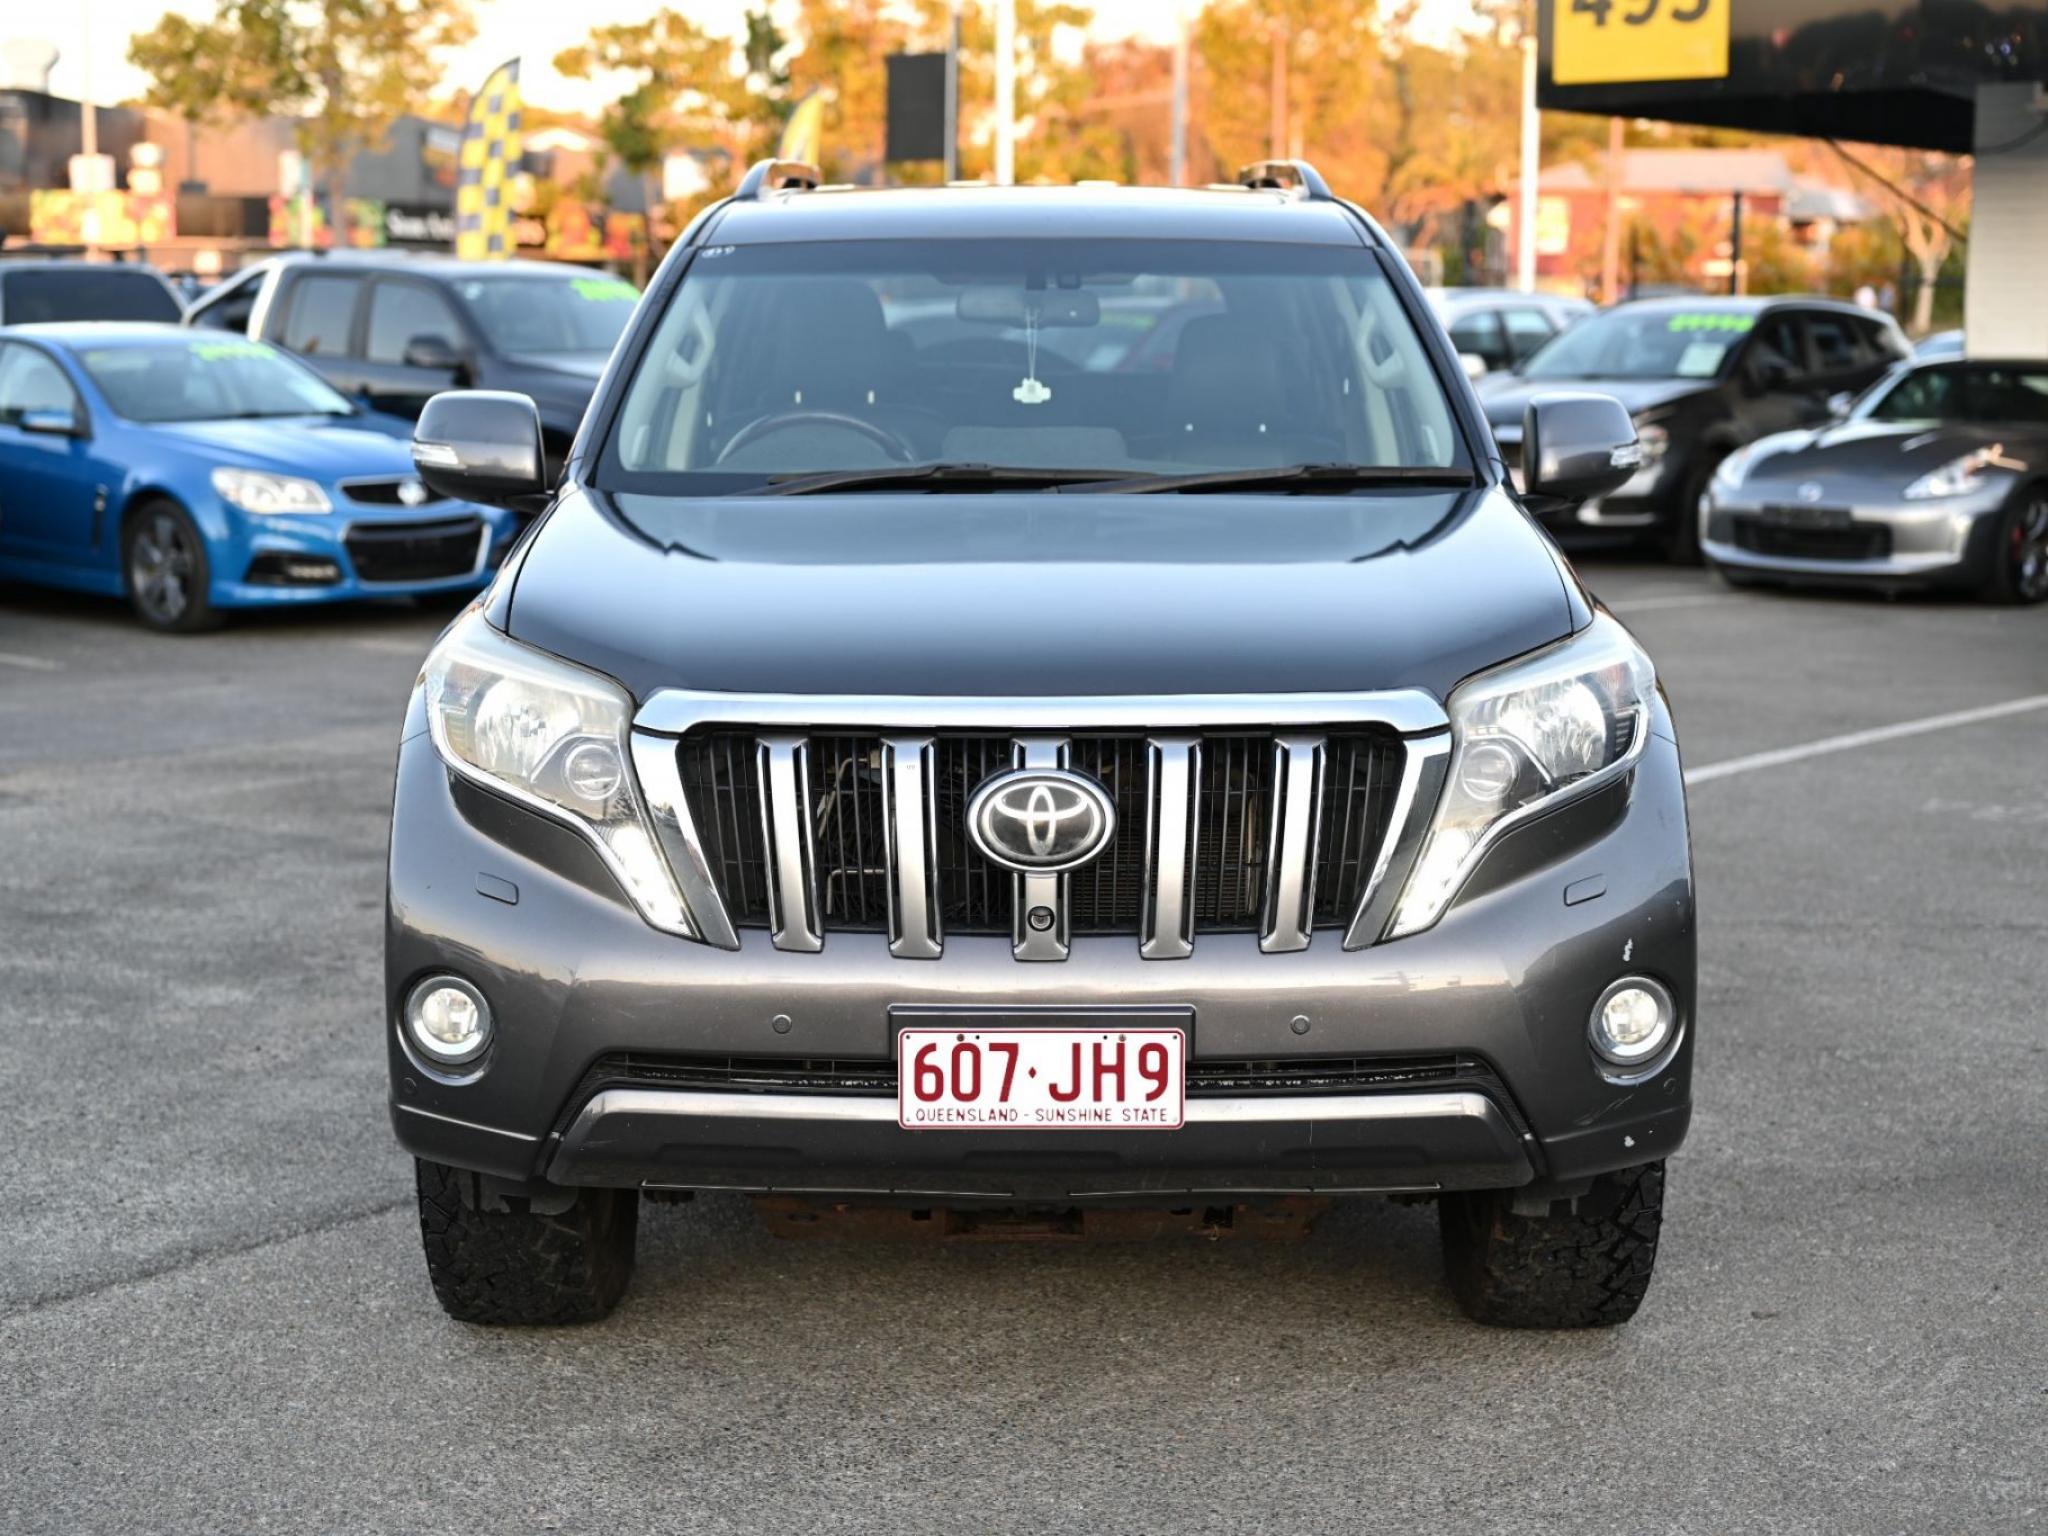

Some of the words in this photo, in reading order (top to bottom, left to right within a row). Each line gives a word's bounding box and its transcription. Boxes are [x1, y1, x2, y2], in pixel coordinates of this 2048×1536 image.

[915, 1108, 1018, 1122] QUEENSLAND
[1035, 1108, 1112, 1122] SUNSHINE
[1122, 1108, 1167, 1122] STATE
